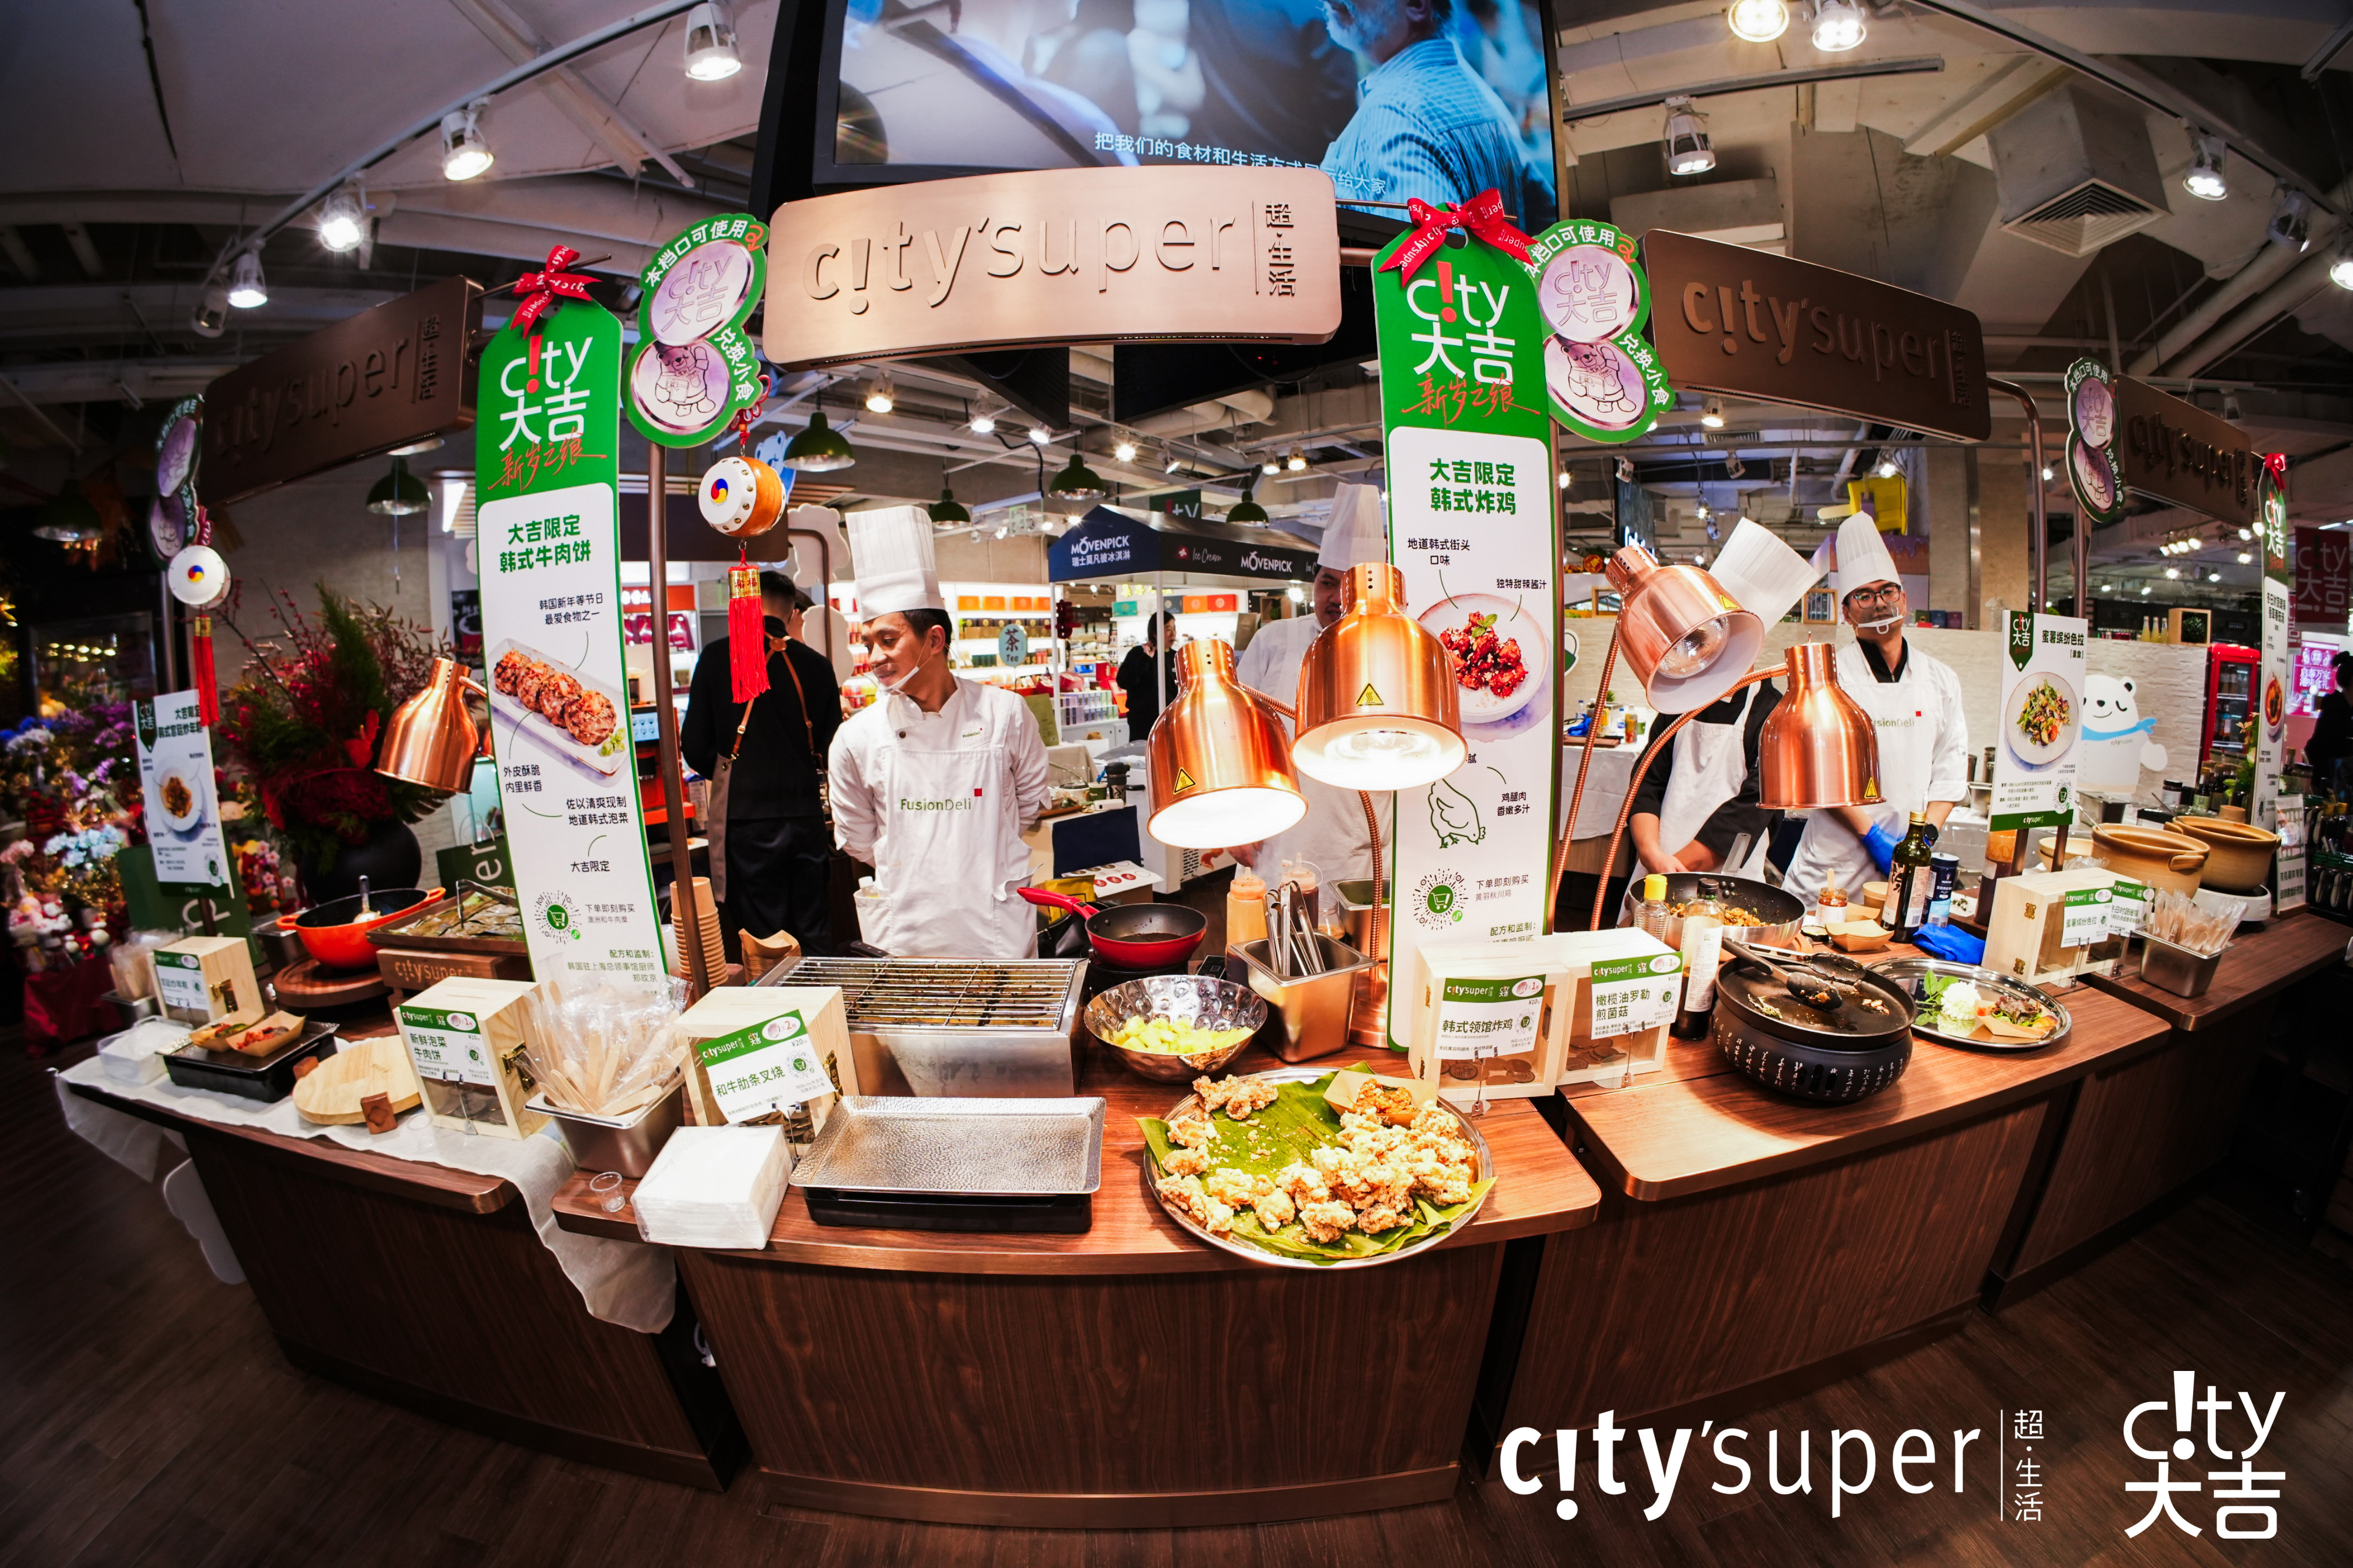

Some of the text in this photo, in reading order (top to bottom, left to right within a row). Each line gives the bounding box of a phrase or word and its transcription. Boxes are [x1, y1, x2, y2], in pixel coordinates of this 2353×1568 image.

[645, 219, 748, 288] 本档口可使用
[1524, 225, 1615, 278] 本档口可使用
[661, 285, 729, 332] 大吉
[1557, 288, 1618, 326] 大吉
[1411, 321, 1515, 386] 大吉
[716, 327, 755, 402] 兑换小食
[1618, 332, 1669, 406] 兑换小食
[2069, 362, 2108, 393] 本档口可使用
[499, 383, 591, 452] 大吉
[2082, 411, 2107, 437] 大吉
[1429, 458, 1516, 488] 大吉限定
[1431, 486, 1517, 515] 韩式炸鸡
[508, 514, 581, 545] 大吉限定
[1407, 538, 1471, 552] 地道韩式街头
[499, 539, 592, 574] 韩式牛肉饼
[1072, 550, 1131, 567] 瑞士莫凡彼冰淇淋
[1192, 548, 1222, 563] Ice Cream
[1430, 555, 1451, 566] 口味
[1496, 578, 1547, 590] 独特甜辣酱汁
[2297, 571, 2348, 605] 大吉
[539, 592, 604, 610] 韩国新年等节日
[545, 610, 600, 625] 最爱食物之一
[1005, 628, 1019, 652] 茶
[2012, 630, 2031, 646] 大吉
[2042, 629, 2085, 646] 蜜薯缤纷色拉
[1006, 654, 1019, 662] Tea
[504, 765, 541, 778] 外皮酥脆
[505, 780, 542, 793] 内里鲜香
[566, 796, 627, 810] 佐以清爽现制
[900, 798, 971, 810] FusionDeli
[1501, 791, 1527, 803] 鸡腿肉
[568, 812, 629, 826] 地道韩式泡菜
[1497, 805, 1531, 817] 香嫩多汁
[570, 860, 611, 873] 大吉限定
[1476, 874, 1529, 890] 下单即刻购买
[585, 903, 636, 913] 下单即刻购买
[567, 962, 655, 972] 韩国驻上海总领事馆厨师
[1596, 988, 1650, 1007] 橄榄油罗勒
[1596, 1005, 1629, 1022] 煎菌菇
[1442, 1018, 1514, 1033] 韩式领馆炸鸡
[409, 1033, 448, 1047] 新鲜泡菜
[414, 1047, 442, 1061] 牛肉饼
[715, 1066, 785, 1097] 和牛肋条叉烧
